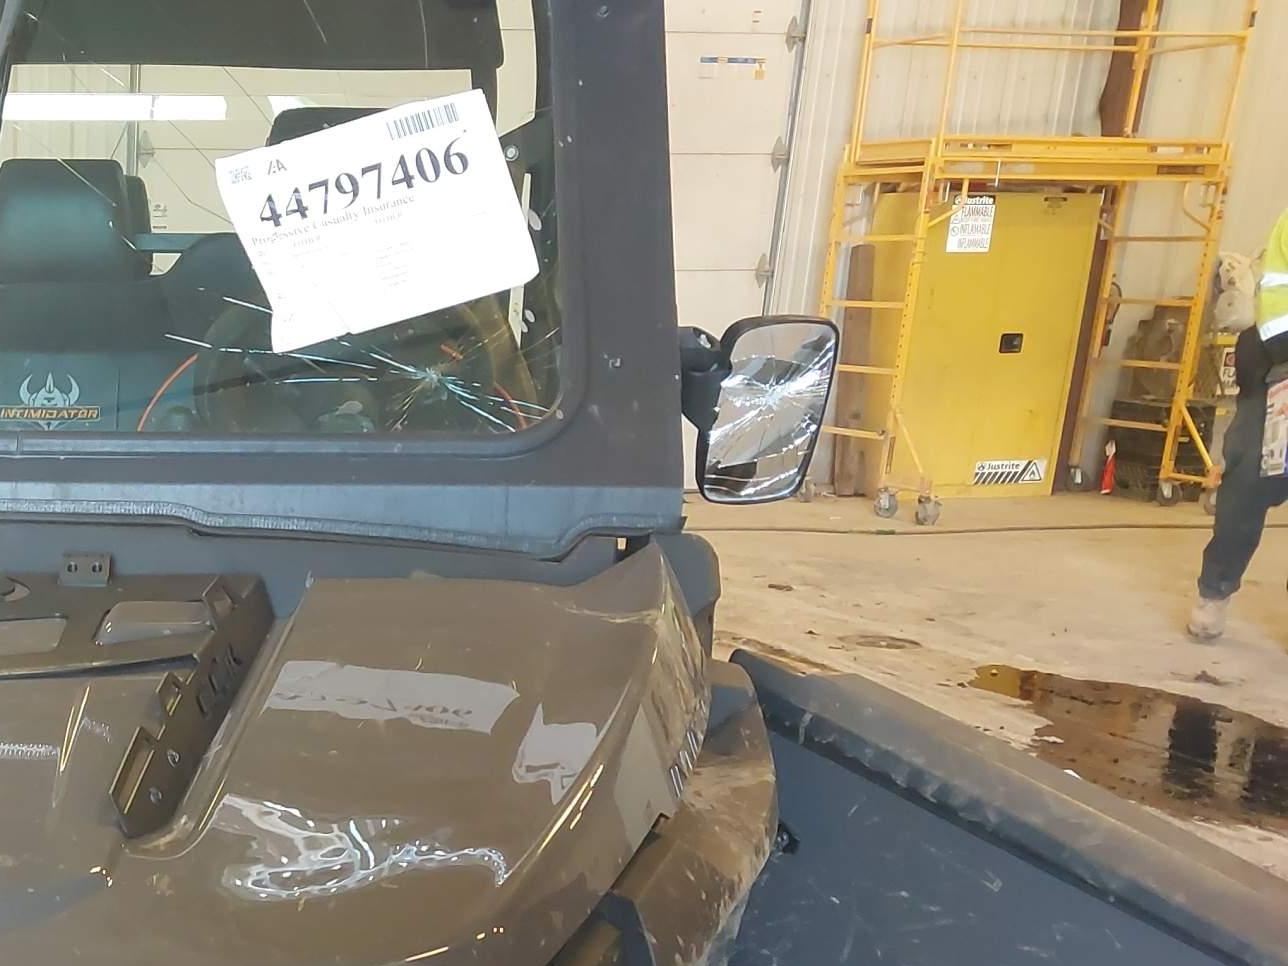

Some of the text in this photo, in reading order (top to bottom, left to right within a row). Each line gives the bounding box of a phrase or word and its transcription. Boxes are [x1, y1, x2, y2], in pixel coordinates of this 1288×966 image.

[260, 138, 469, 227] 44797406
[362, 195, 415, 217] Insurance
[0, 408, 98, 419] INTIMIDATOR
[986, 463, 1021, 471] Justrite
